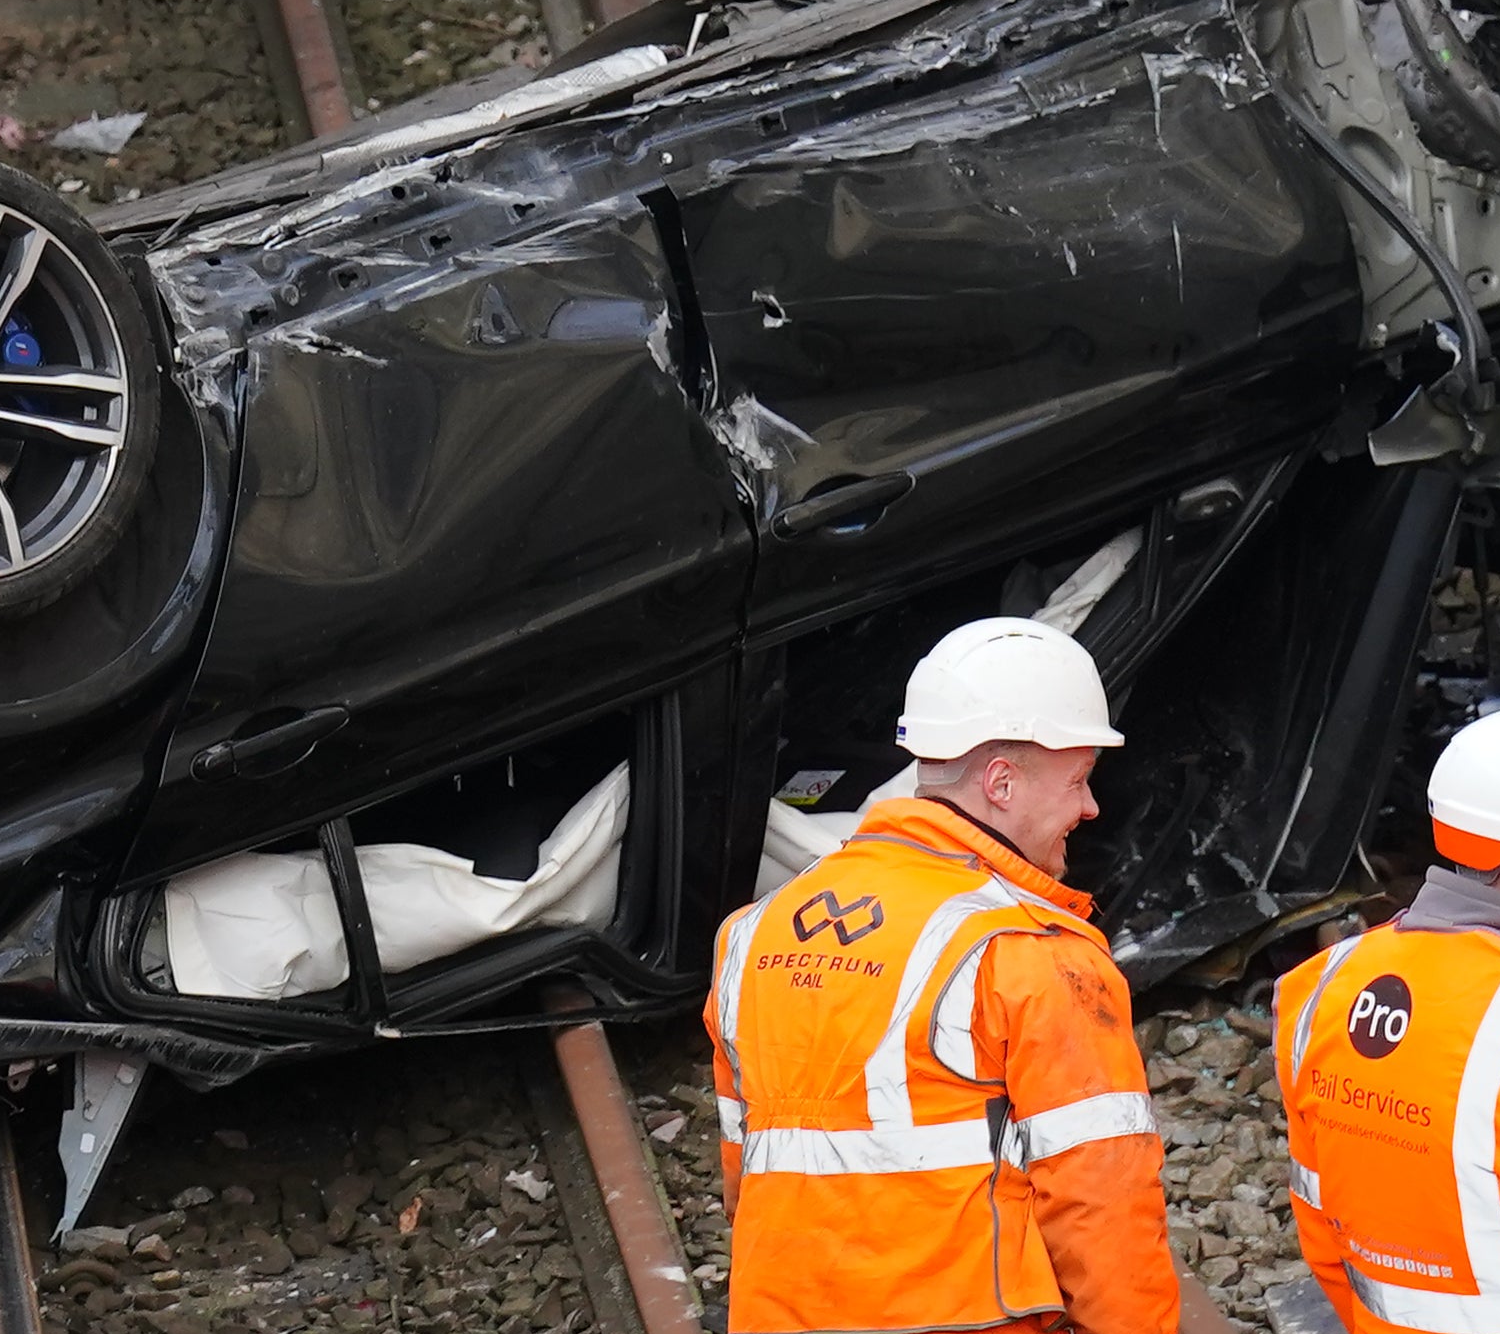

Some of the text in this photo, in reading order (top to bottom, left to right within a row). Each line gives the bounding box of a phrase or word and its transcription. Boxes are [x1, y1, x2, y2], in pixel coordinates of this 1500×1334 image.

[757, 953, 885, 978] SPECTRUM
[790, 972, 823, 988] RAIL
[1348, 990, 1409, 1043] Pro
[1311, 1070, 1432, 1127] Rail Services
